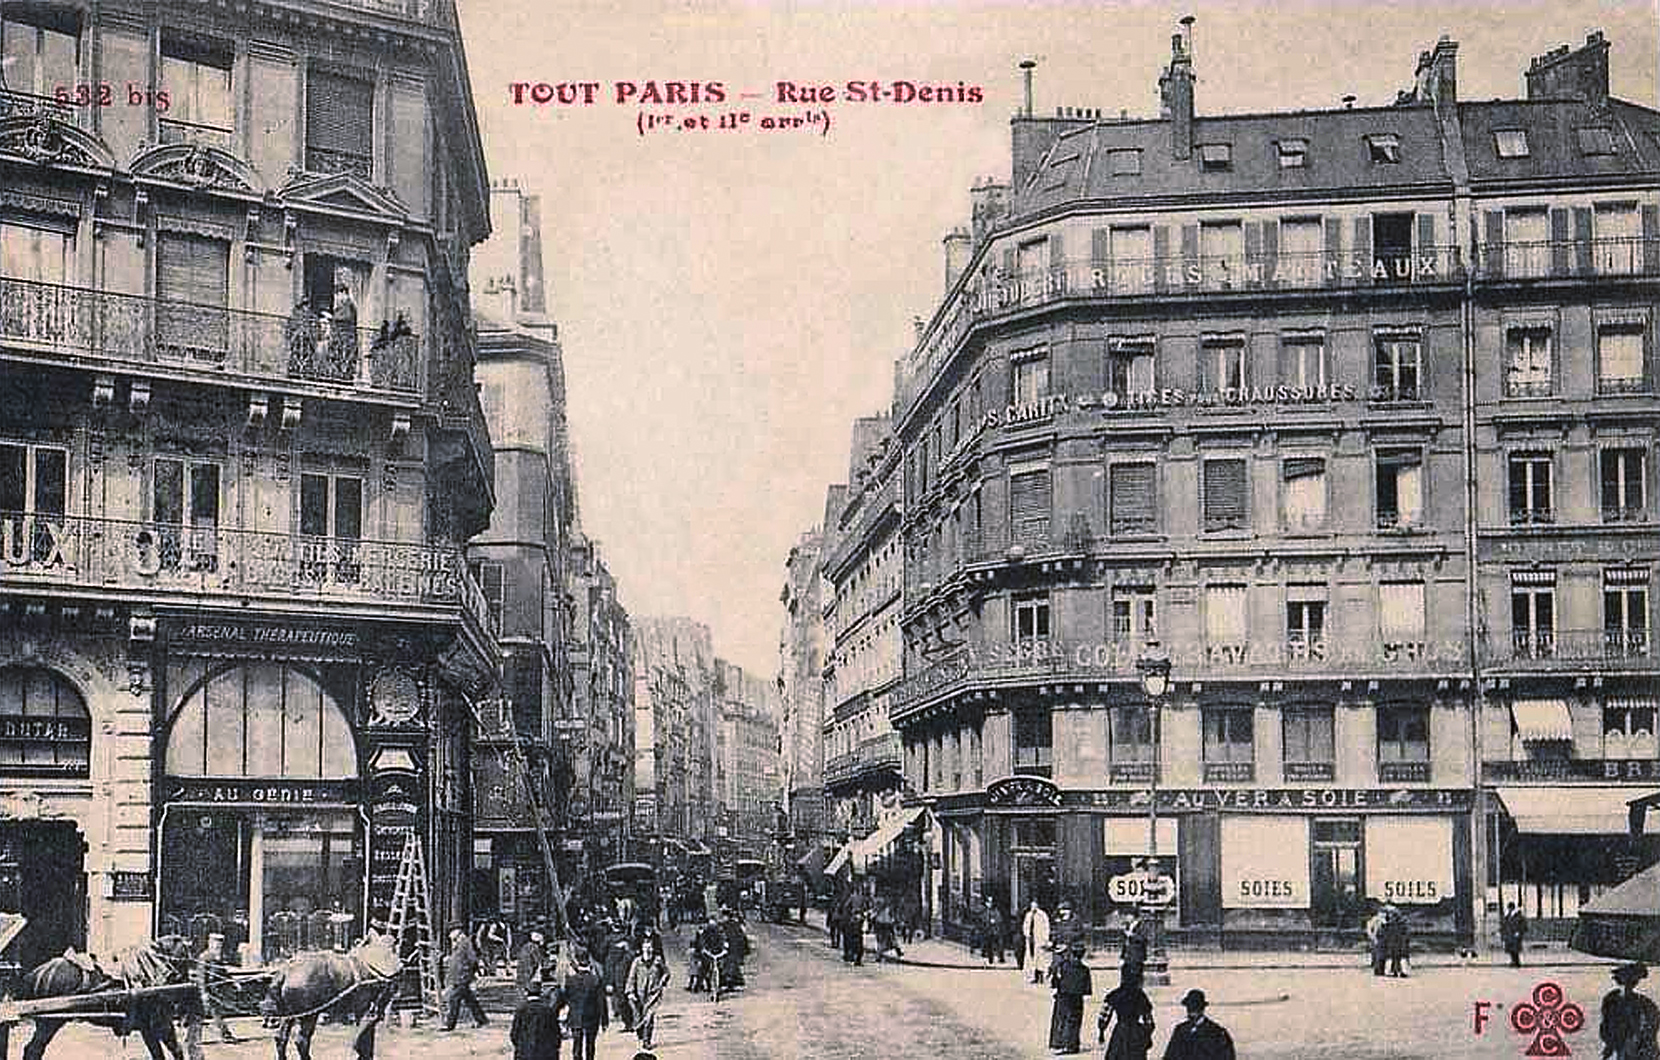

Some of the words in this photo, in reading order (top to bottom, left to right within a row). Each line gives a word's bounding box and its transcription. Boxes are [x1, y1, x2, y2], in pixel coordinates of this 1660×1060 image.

[1225, 384, 1356, 403] CHAUSSURES
[214, 787, 239, 801] AU
[1173, 791, 1205, 808] AU
[1213, 789, 1268, 808] VER
[1302, 790, 1367, 807] SOIE
[1240, 880, 1292, 897] SOIES
